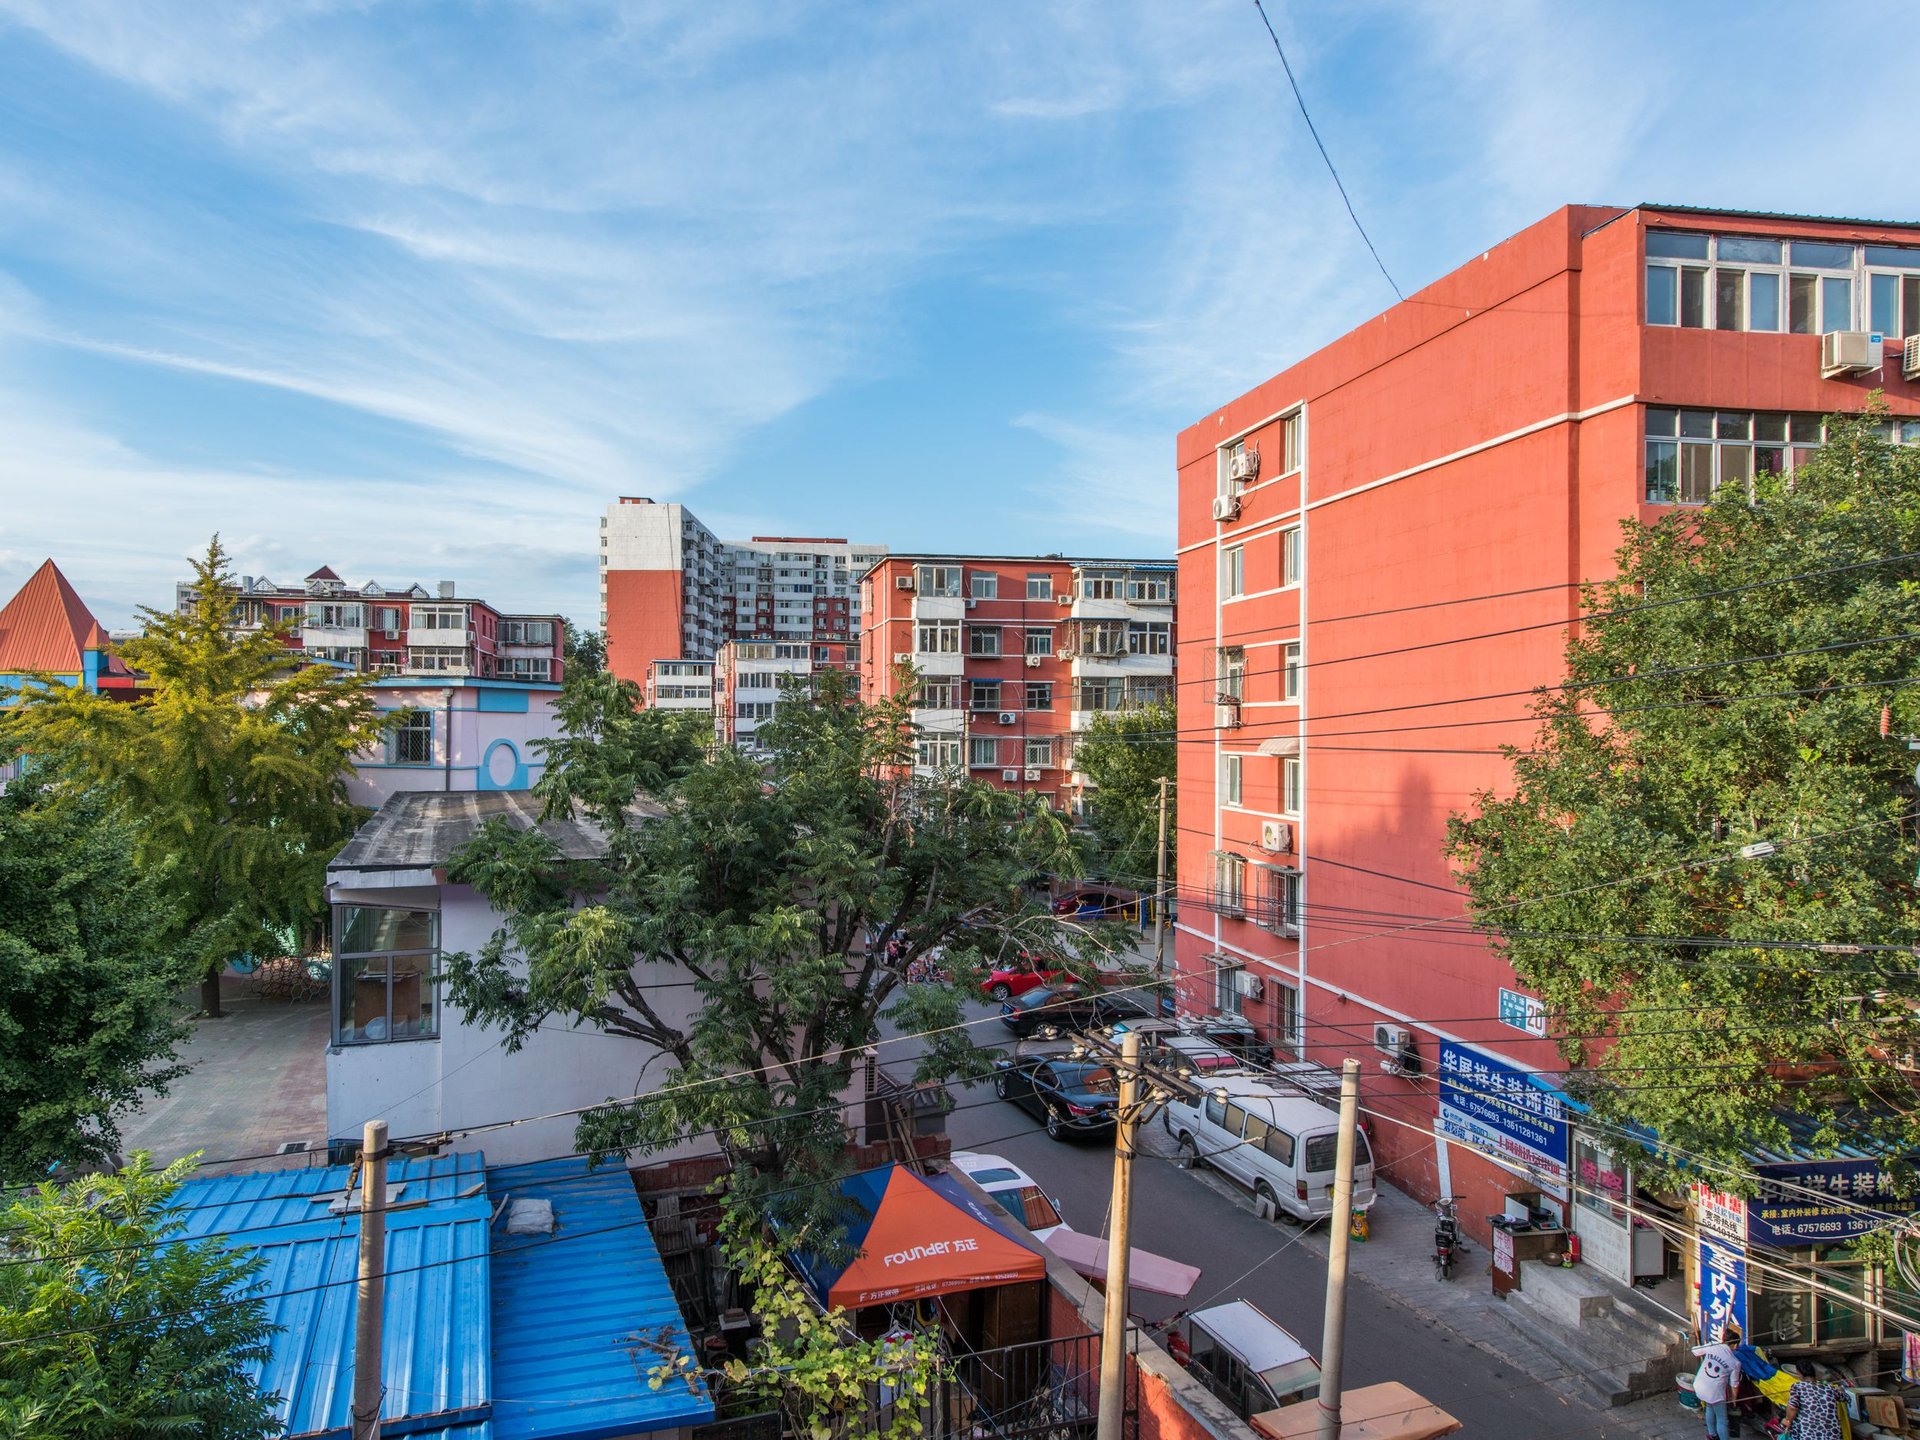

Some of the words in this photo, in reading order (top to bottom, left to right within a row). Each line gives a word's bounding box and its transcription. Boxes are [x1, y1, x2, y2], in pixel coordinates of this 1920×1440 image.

[1527, 1003, 1543, 1031] 20
[1443, 1049, 1562, 1119] 华展祥生装饰部
[1503, 1118, 1548, 1146] 13611281361
[1754, 1171, 1920, 1204] 华展祥生装饰
[1847, 1219, 1882, 1231] 136112
[952, 1238, 979, 1253] 方正
